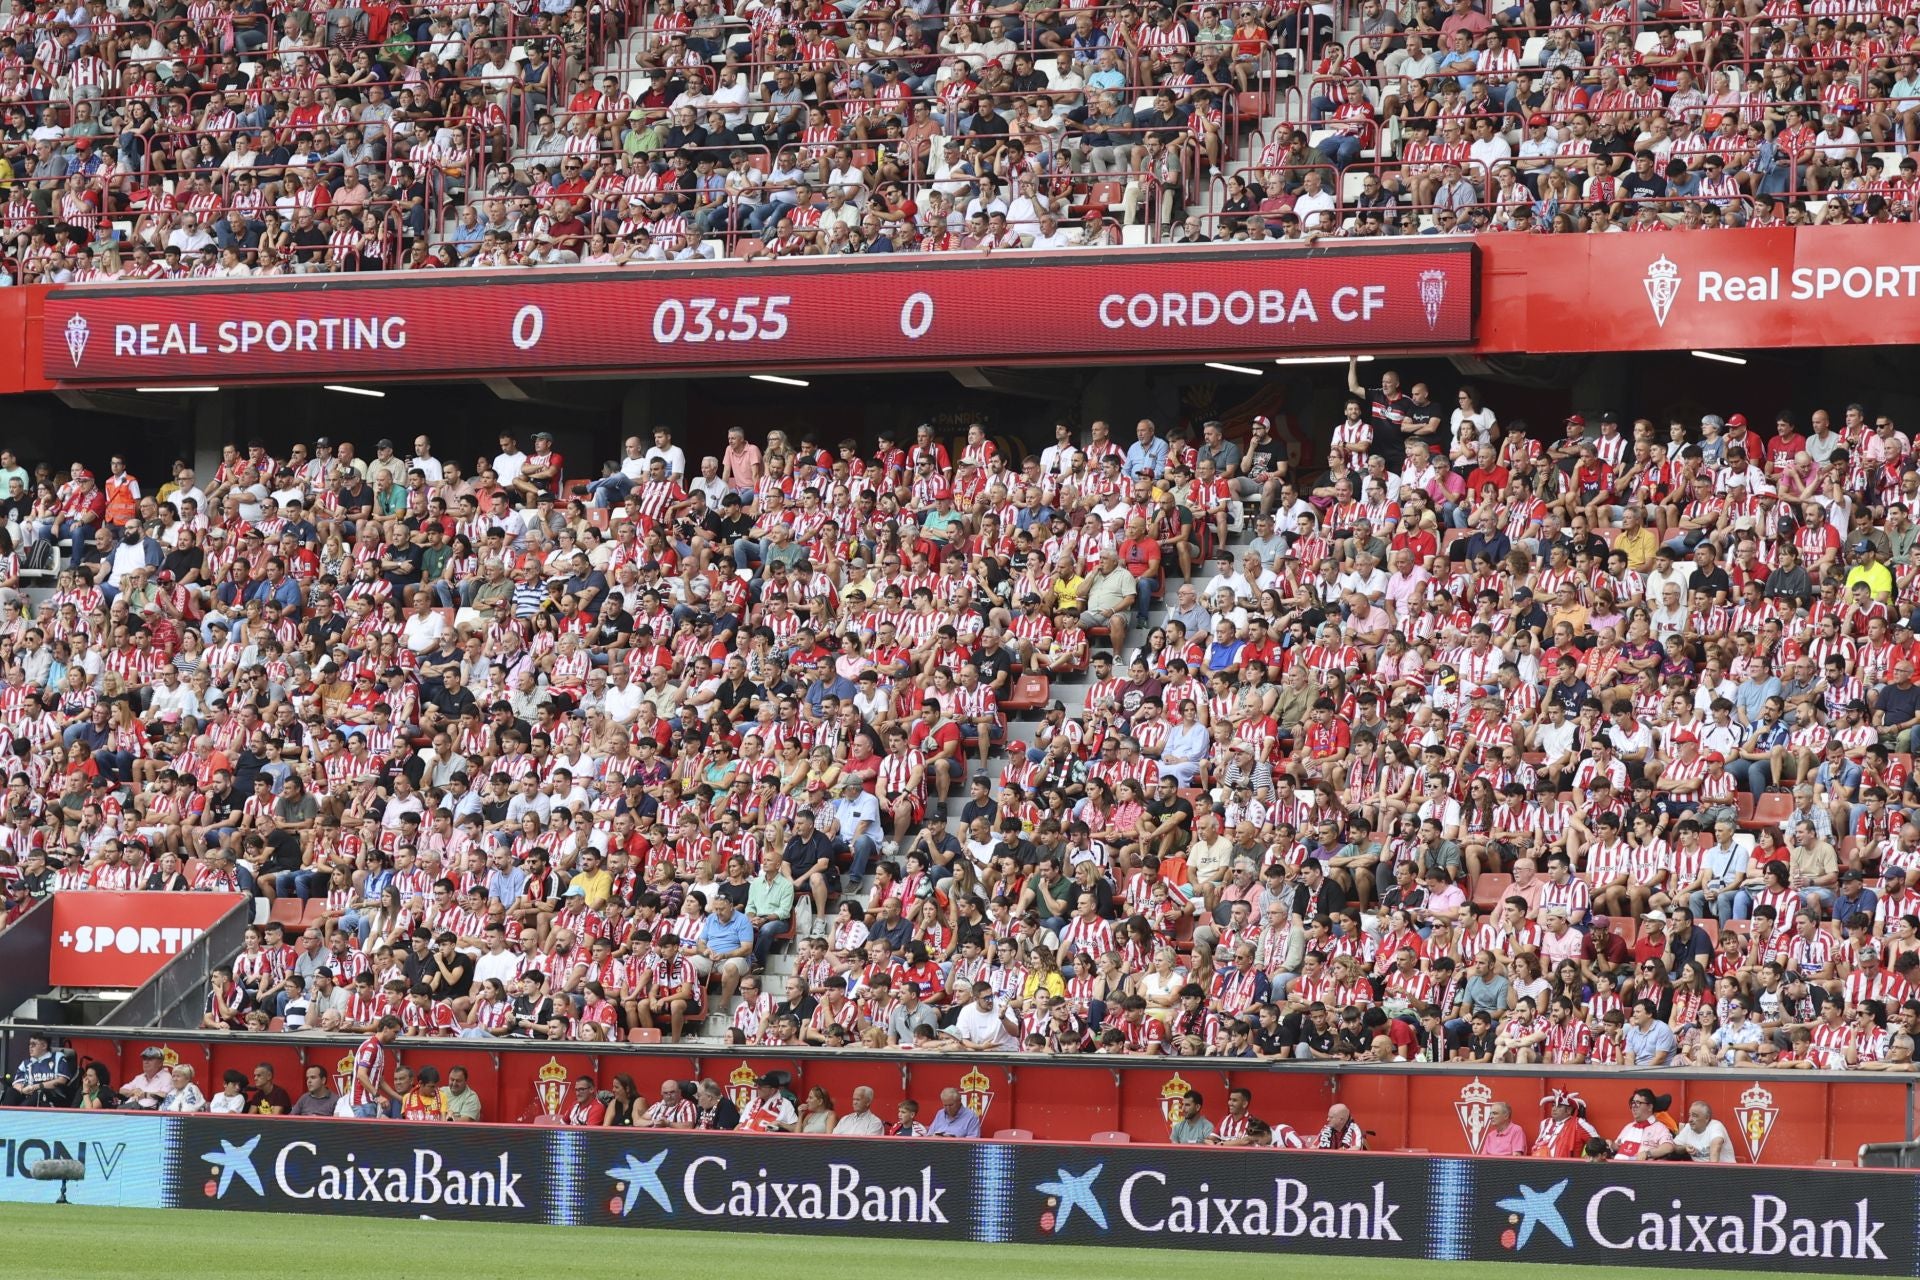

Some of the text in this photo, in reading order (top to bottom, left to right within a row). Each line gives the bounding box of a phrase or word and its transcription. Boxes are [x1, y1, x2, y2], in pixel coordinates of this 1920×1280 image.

[1099, 285, 1386, 329] CORDOBA CF
[1699, 268, 1779, 301] Real
[115, 316, 406, 356] REAL SPORTING
[512, 304, 543, 350] 0
[652, 295, 791, 343] 03:55
[900, 291, 934, 339] 0
[92, 1141, 127, 1181] V
[274, 1141, 525, 1208] CaixaBank
[683, 1155, 949, 1224] CaixaBank
[1119, 1170, 1403, 1241] CaixaBank
[1586, 1186, 1888, 1260] CaixaBank
